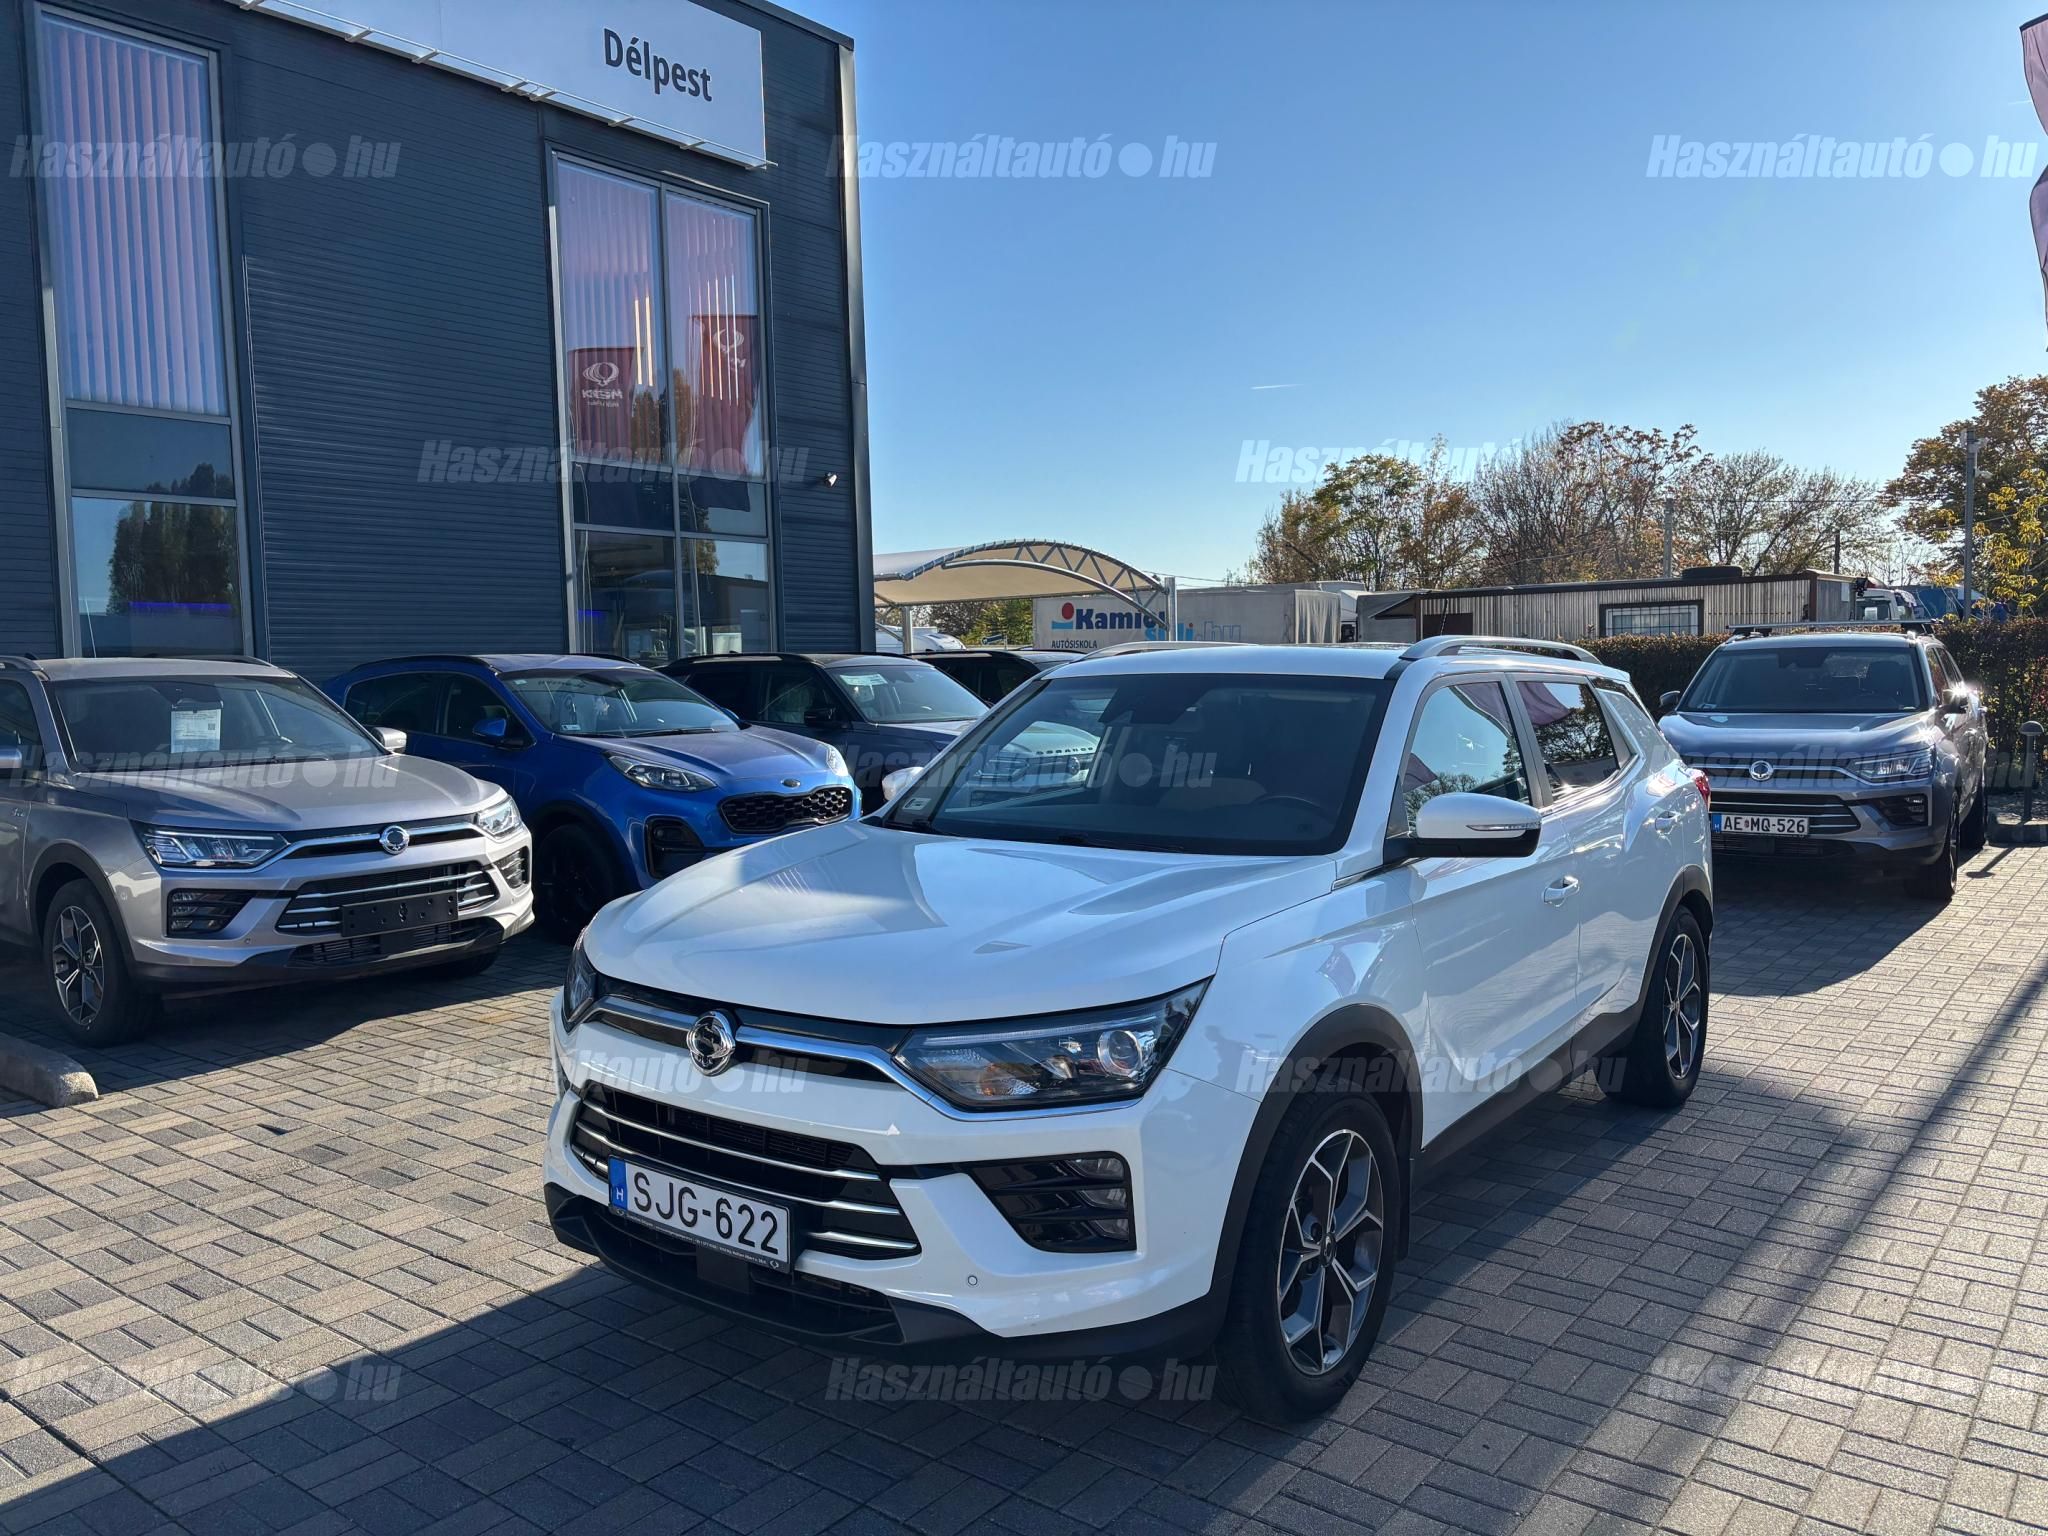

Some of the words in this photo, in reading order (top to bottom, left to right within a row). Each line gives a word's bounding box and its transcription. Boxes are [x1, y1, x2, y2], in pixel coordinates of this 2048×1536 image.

[604, 28, 713, 102] Délpest
[1051, 638, 1098, 649] AUTÓSISKOLA
[615, 1186, 625, 1203] H
[633, 1171, 779, 1255] SJG-622
